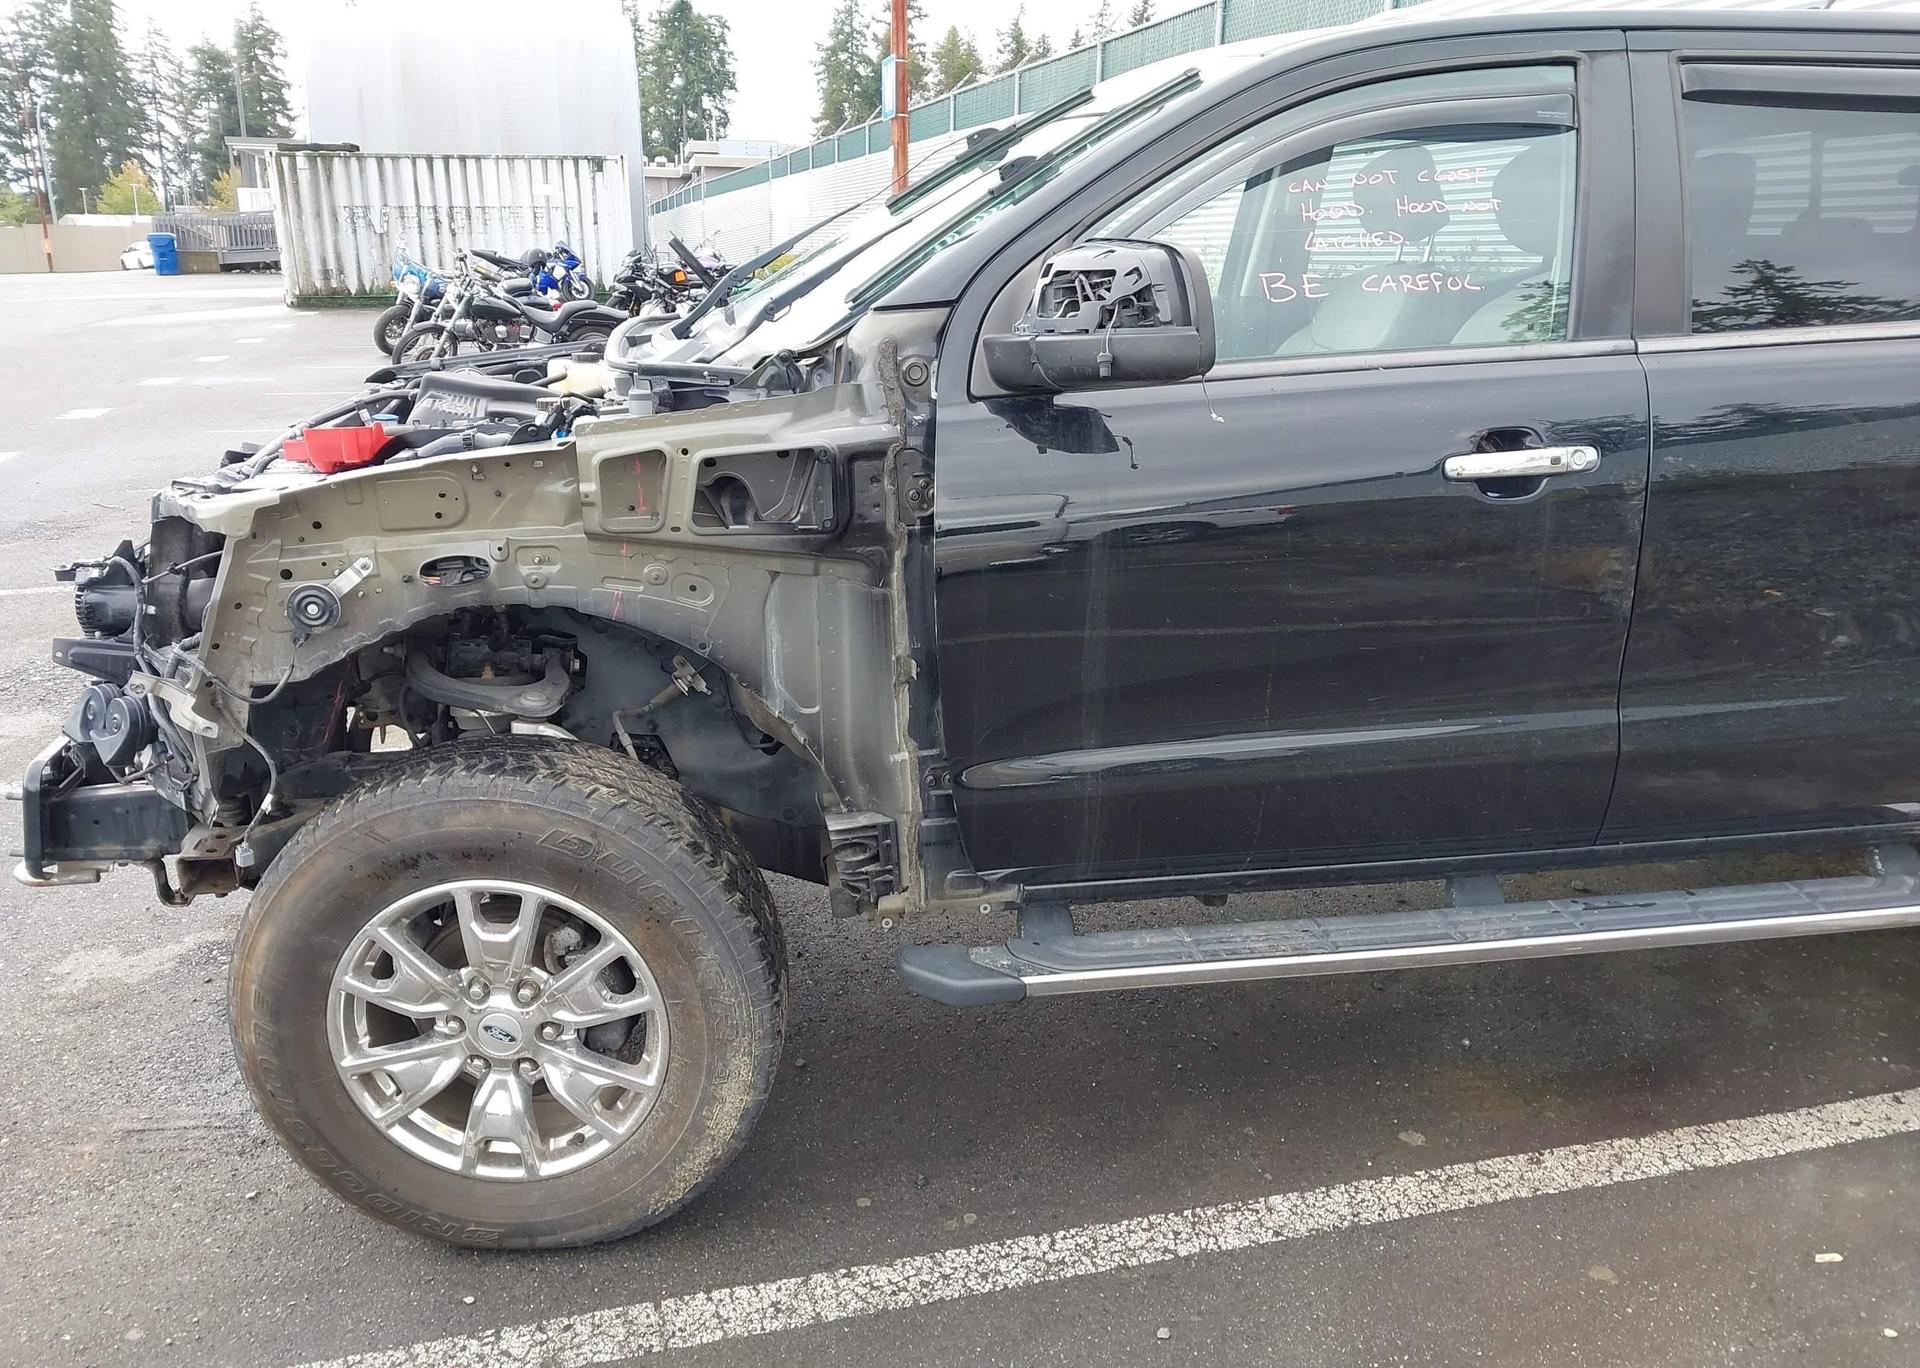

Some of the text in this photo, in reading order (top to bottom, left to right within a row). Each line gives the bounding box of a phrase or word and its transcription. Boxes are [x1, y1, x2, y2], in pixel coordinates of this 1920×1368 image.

[1287, 166, 1489, 194] CAN NOT CLOSE
[1395, 194, 1450, 218] HOOD
[1461, 198, 1503, 213] NOT
[1258, 272, 1487, 303] BE CAREFUL.
[486, 1026, 513, 1042] Ford
